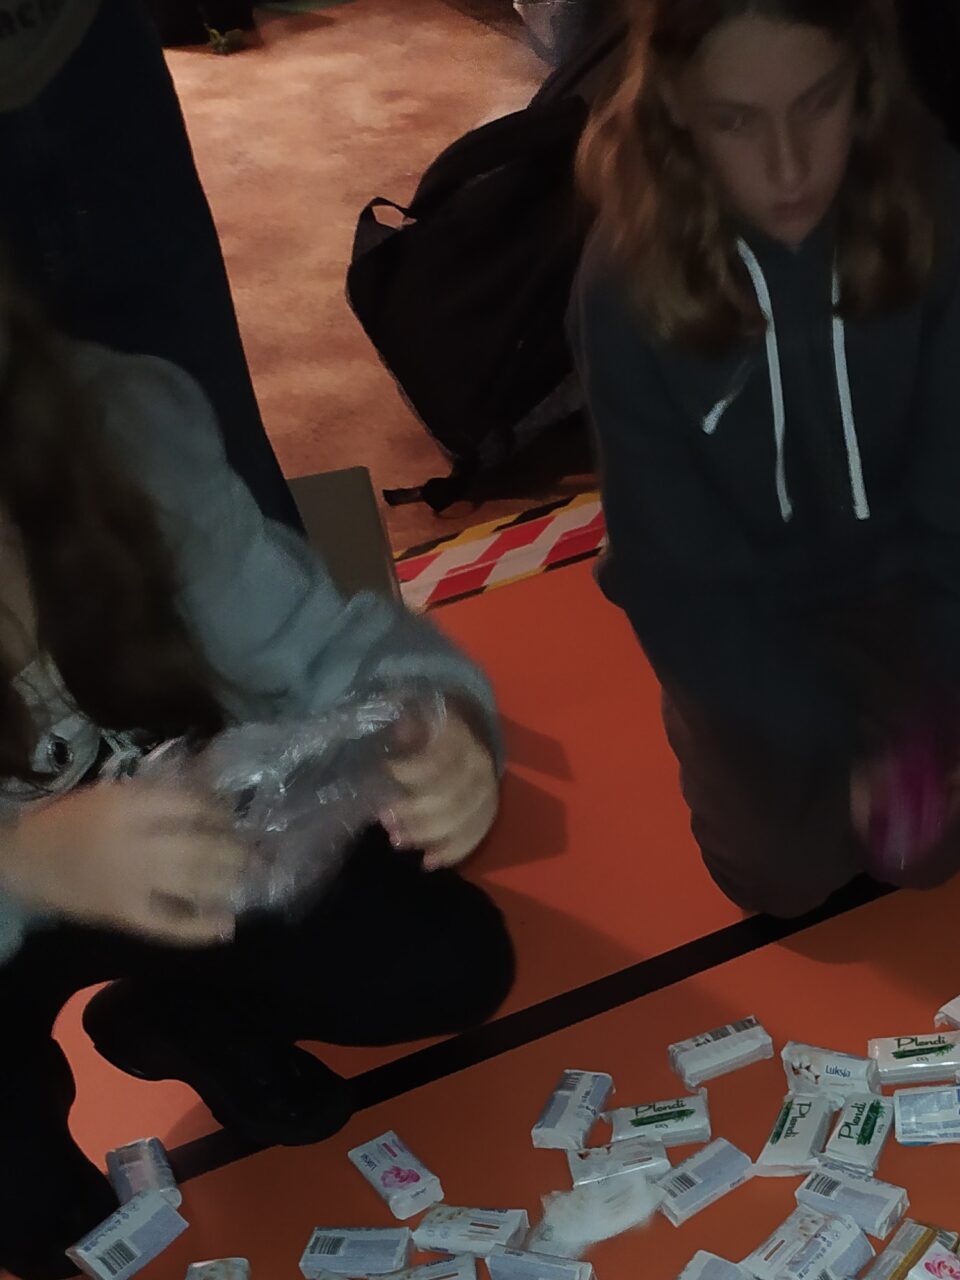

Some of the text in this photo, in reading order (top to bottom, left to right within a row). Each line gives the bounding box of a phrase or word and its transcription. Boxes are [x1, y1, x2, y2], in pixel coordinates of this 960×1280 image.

[894, 1035, 946, 1049] Plendi
[825, 1063, 852, 1079] Luksja
[633, 1100, 686, 1119] Plendi
[784, 1101, 812, 1141] Plendi
[838, 1101, 866, 1141] Plendi
